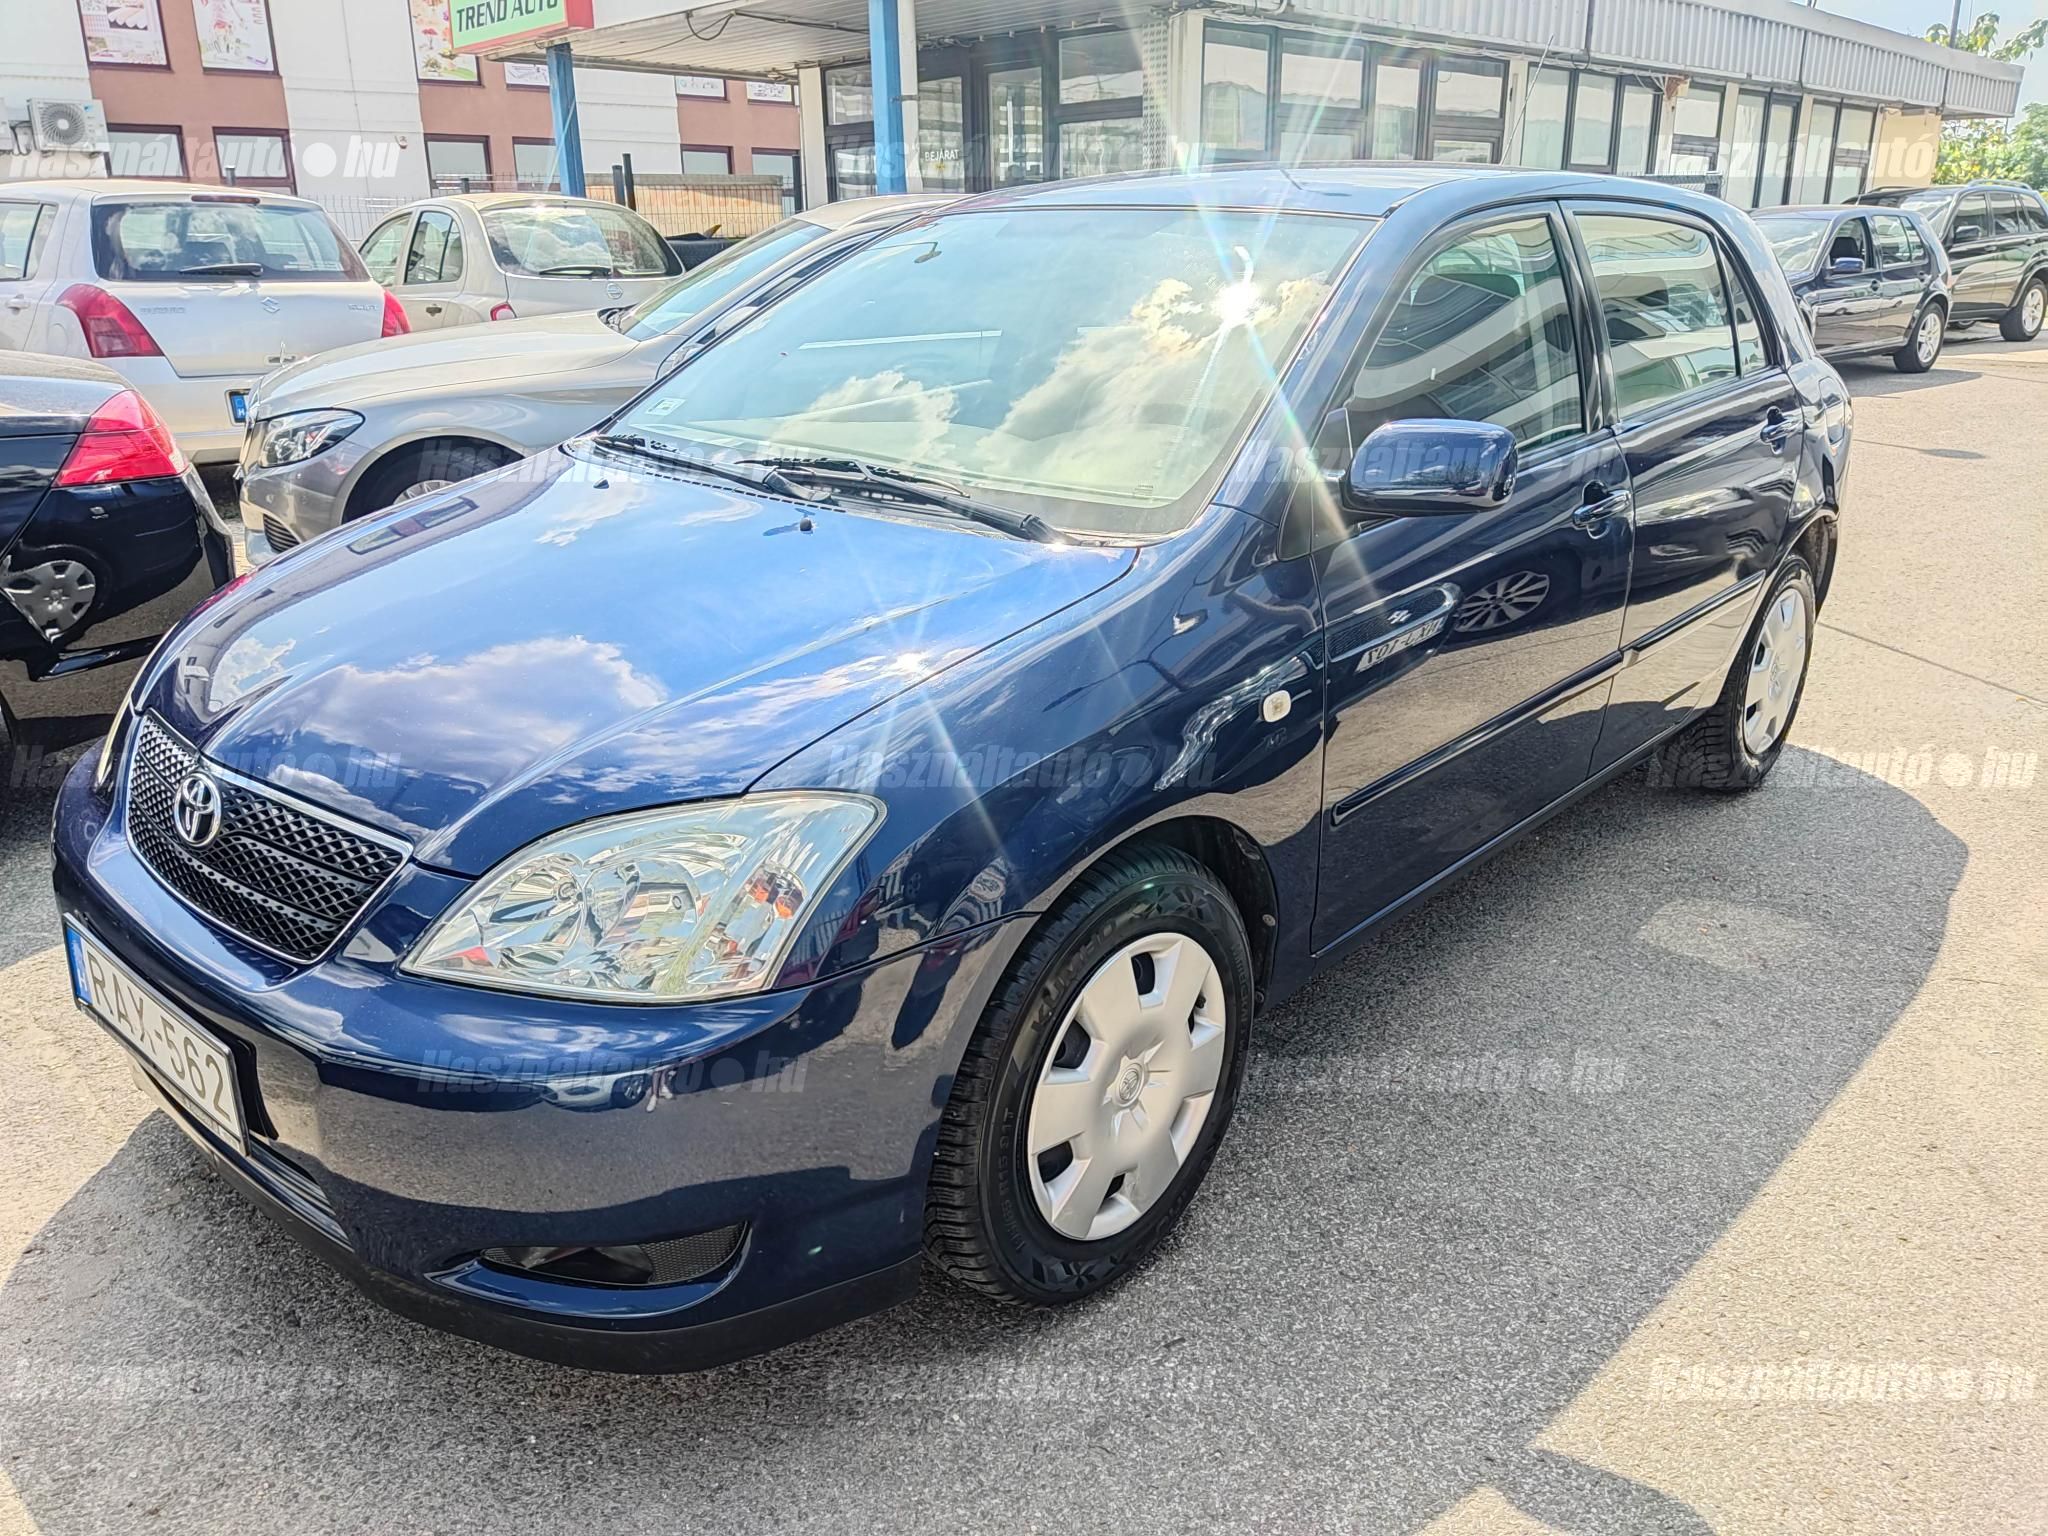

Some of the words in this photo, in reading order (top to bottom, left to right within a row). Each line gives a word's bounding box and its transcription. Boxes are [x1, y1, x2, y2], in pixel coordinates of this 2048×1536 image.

[457, 0, 507, 32] TREND
[924, 148, 960, 162] BEJÁRAT
[1031, 916, 1118, 1034] KUMHO
[87, 949, 233, 1123] RAX-562
